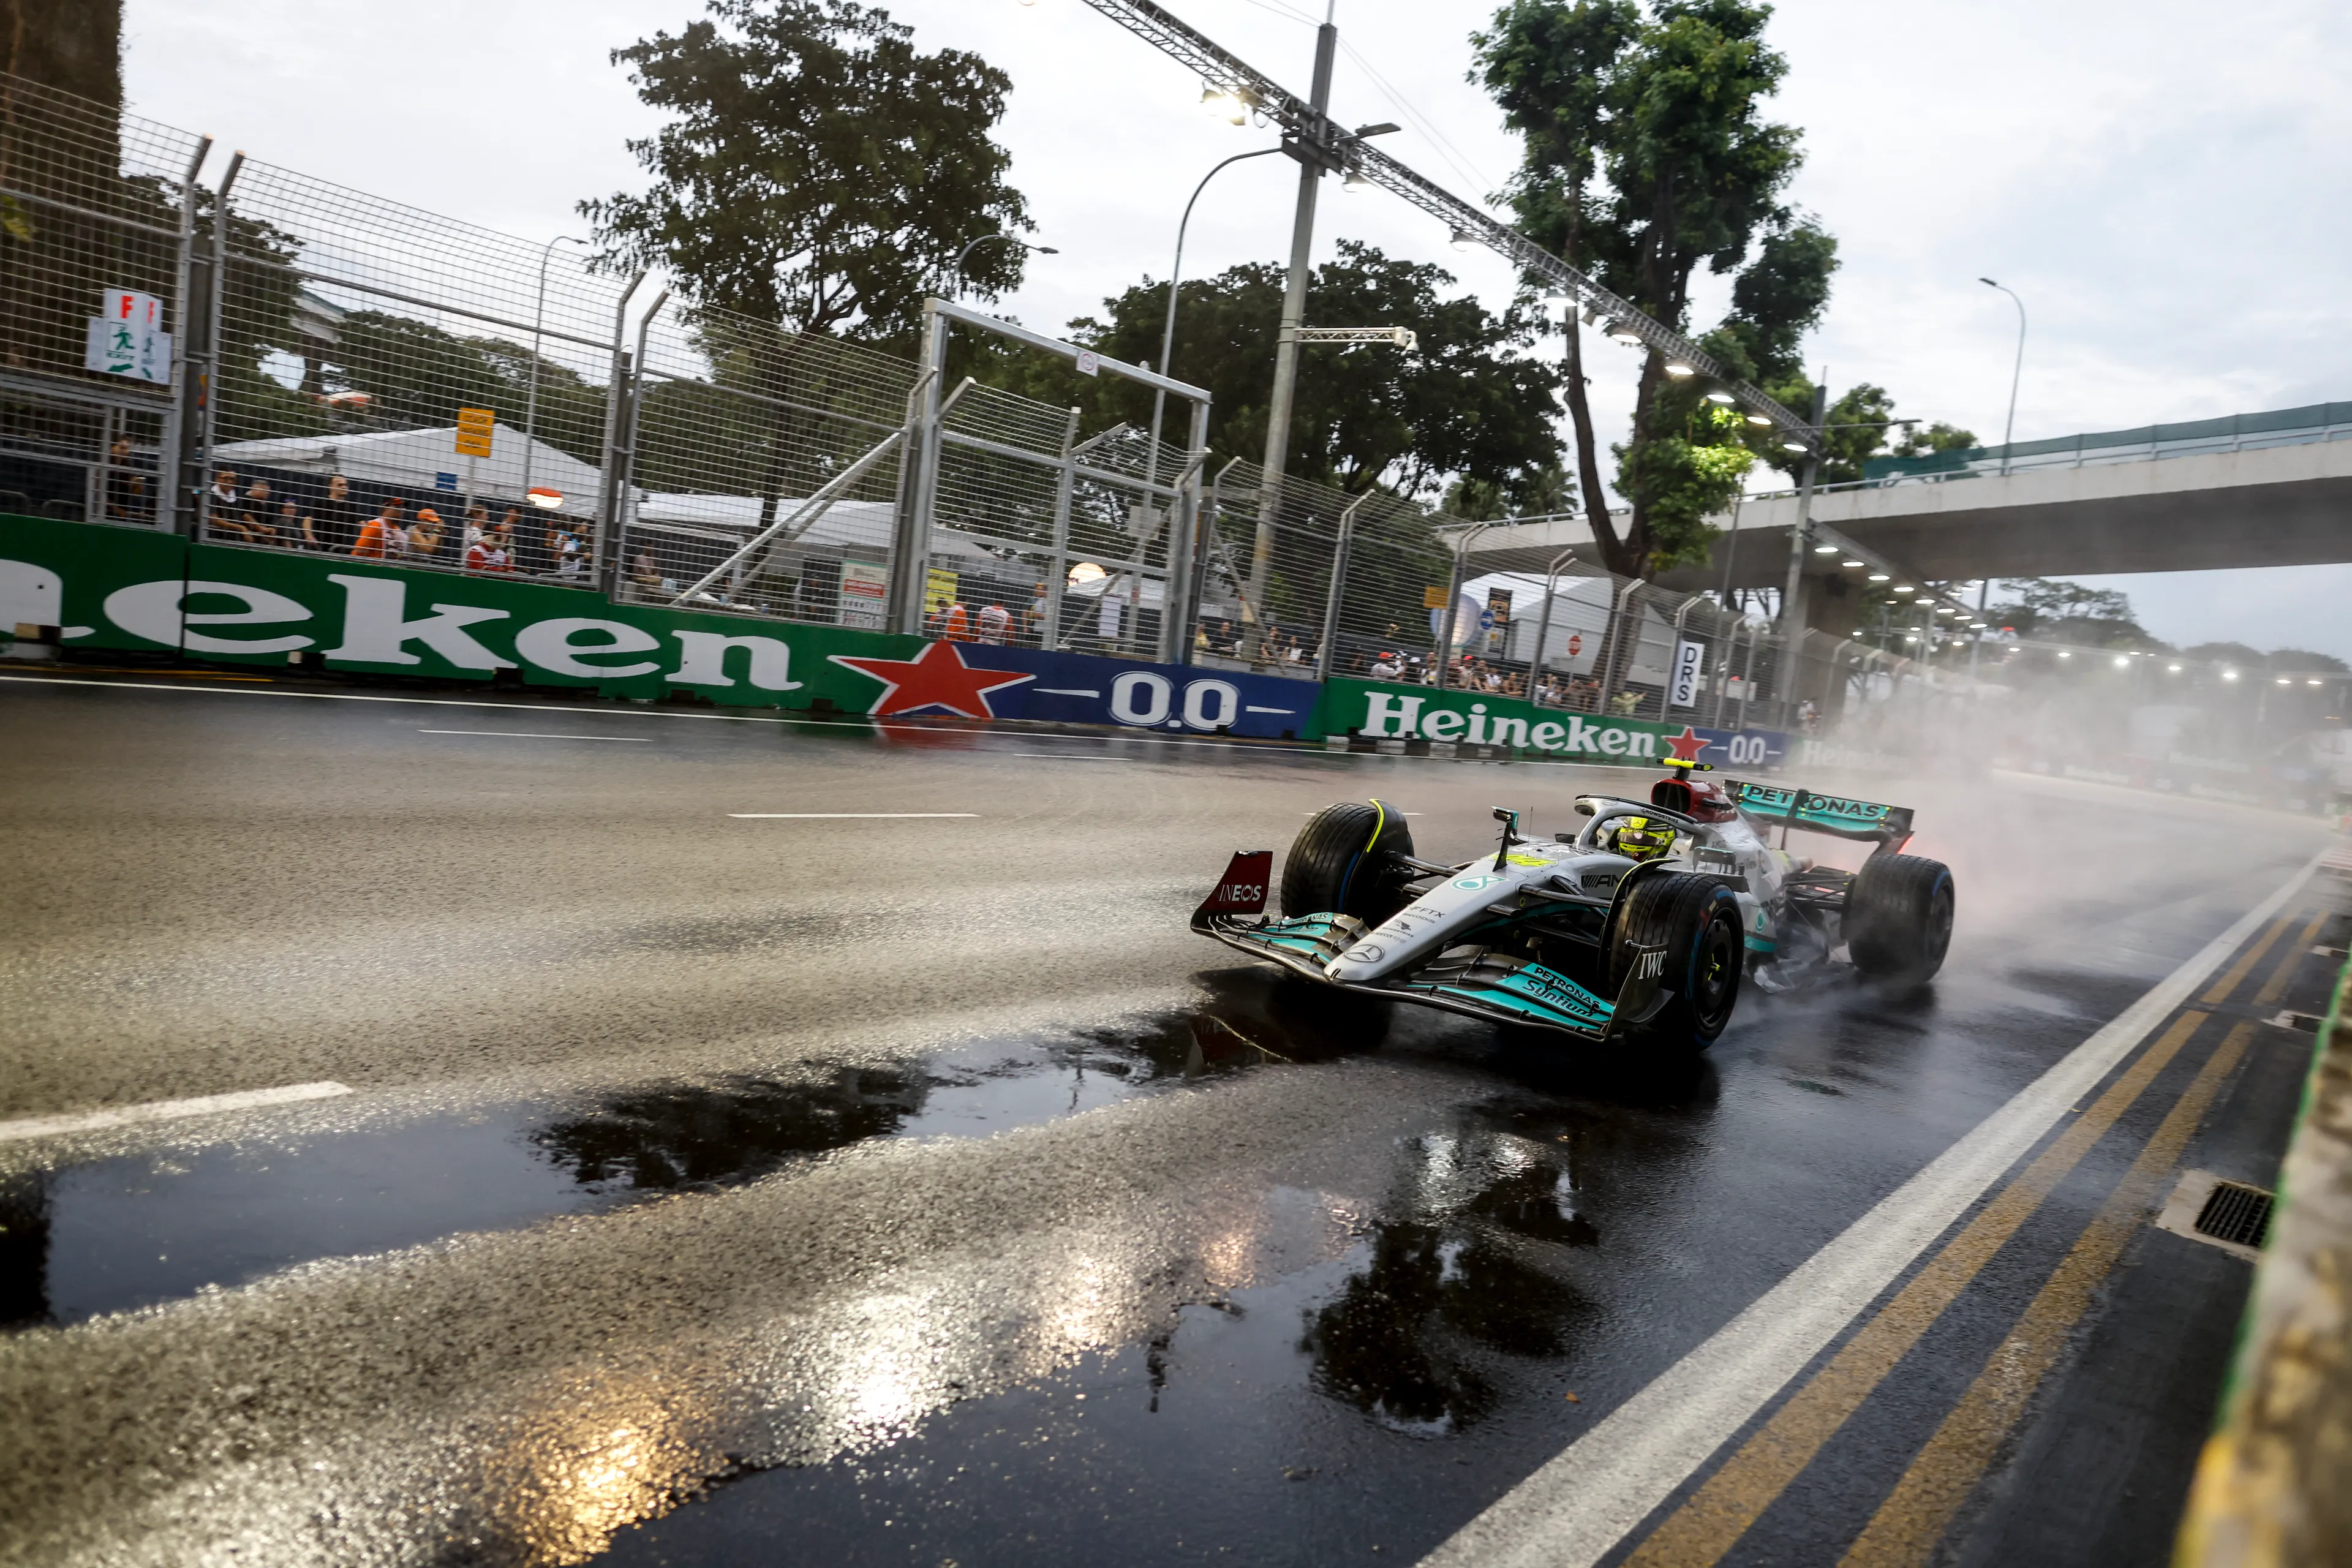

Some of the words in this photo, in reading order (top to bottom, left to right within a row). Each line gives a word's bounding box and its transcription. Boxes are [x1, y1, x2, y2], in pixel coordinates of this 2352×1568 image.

[120, 295, 134, 318] F
[1676, 646, 1697, 703] DRS
[1107, 670, 1241, 730] 0.0
[1359, 691, 1656, 758] Heineken
[1642, 808, 1679, 824] CROWDSTRIKE
[1218, 883, 1262, 903] INEOS
[1420, 907, 1446, 919] FTX
[1638, 950, 1668, 980] IWC
[1522, 979, 1593, 1018] Syntium
[1534, 966, 1601, 1006] PETRONAS
